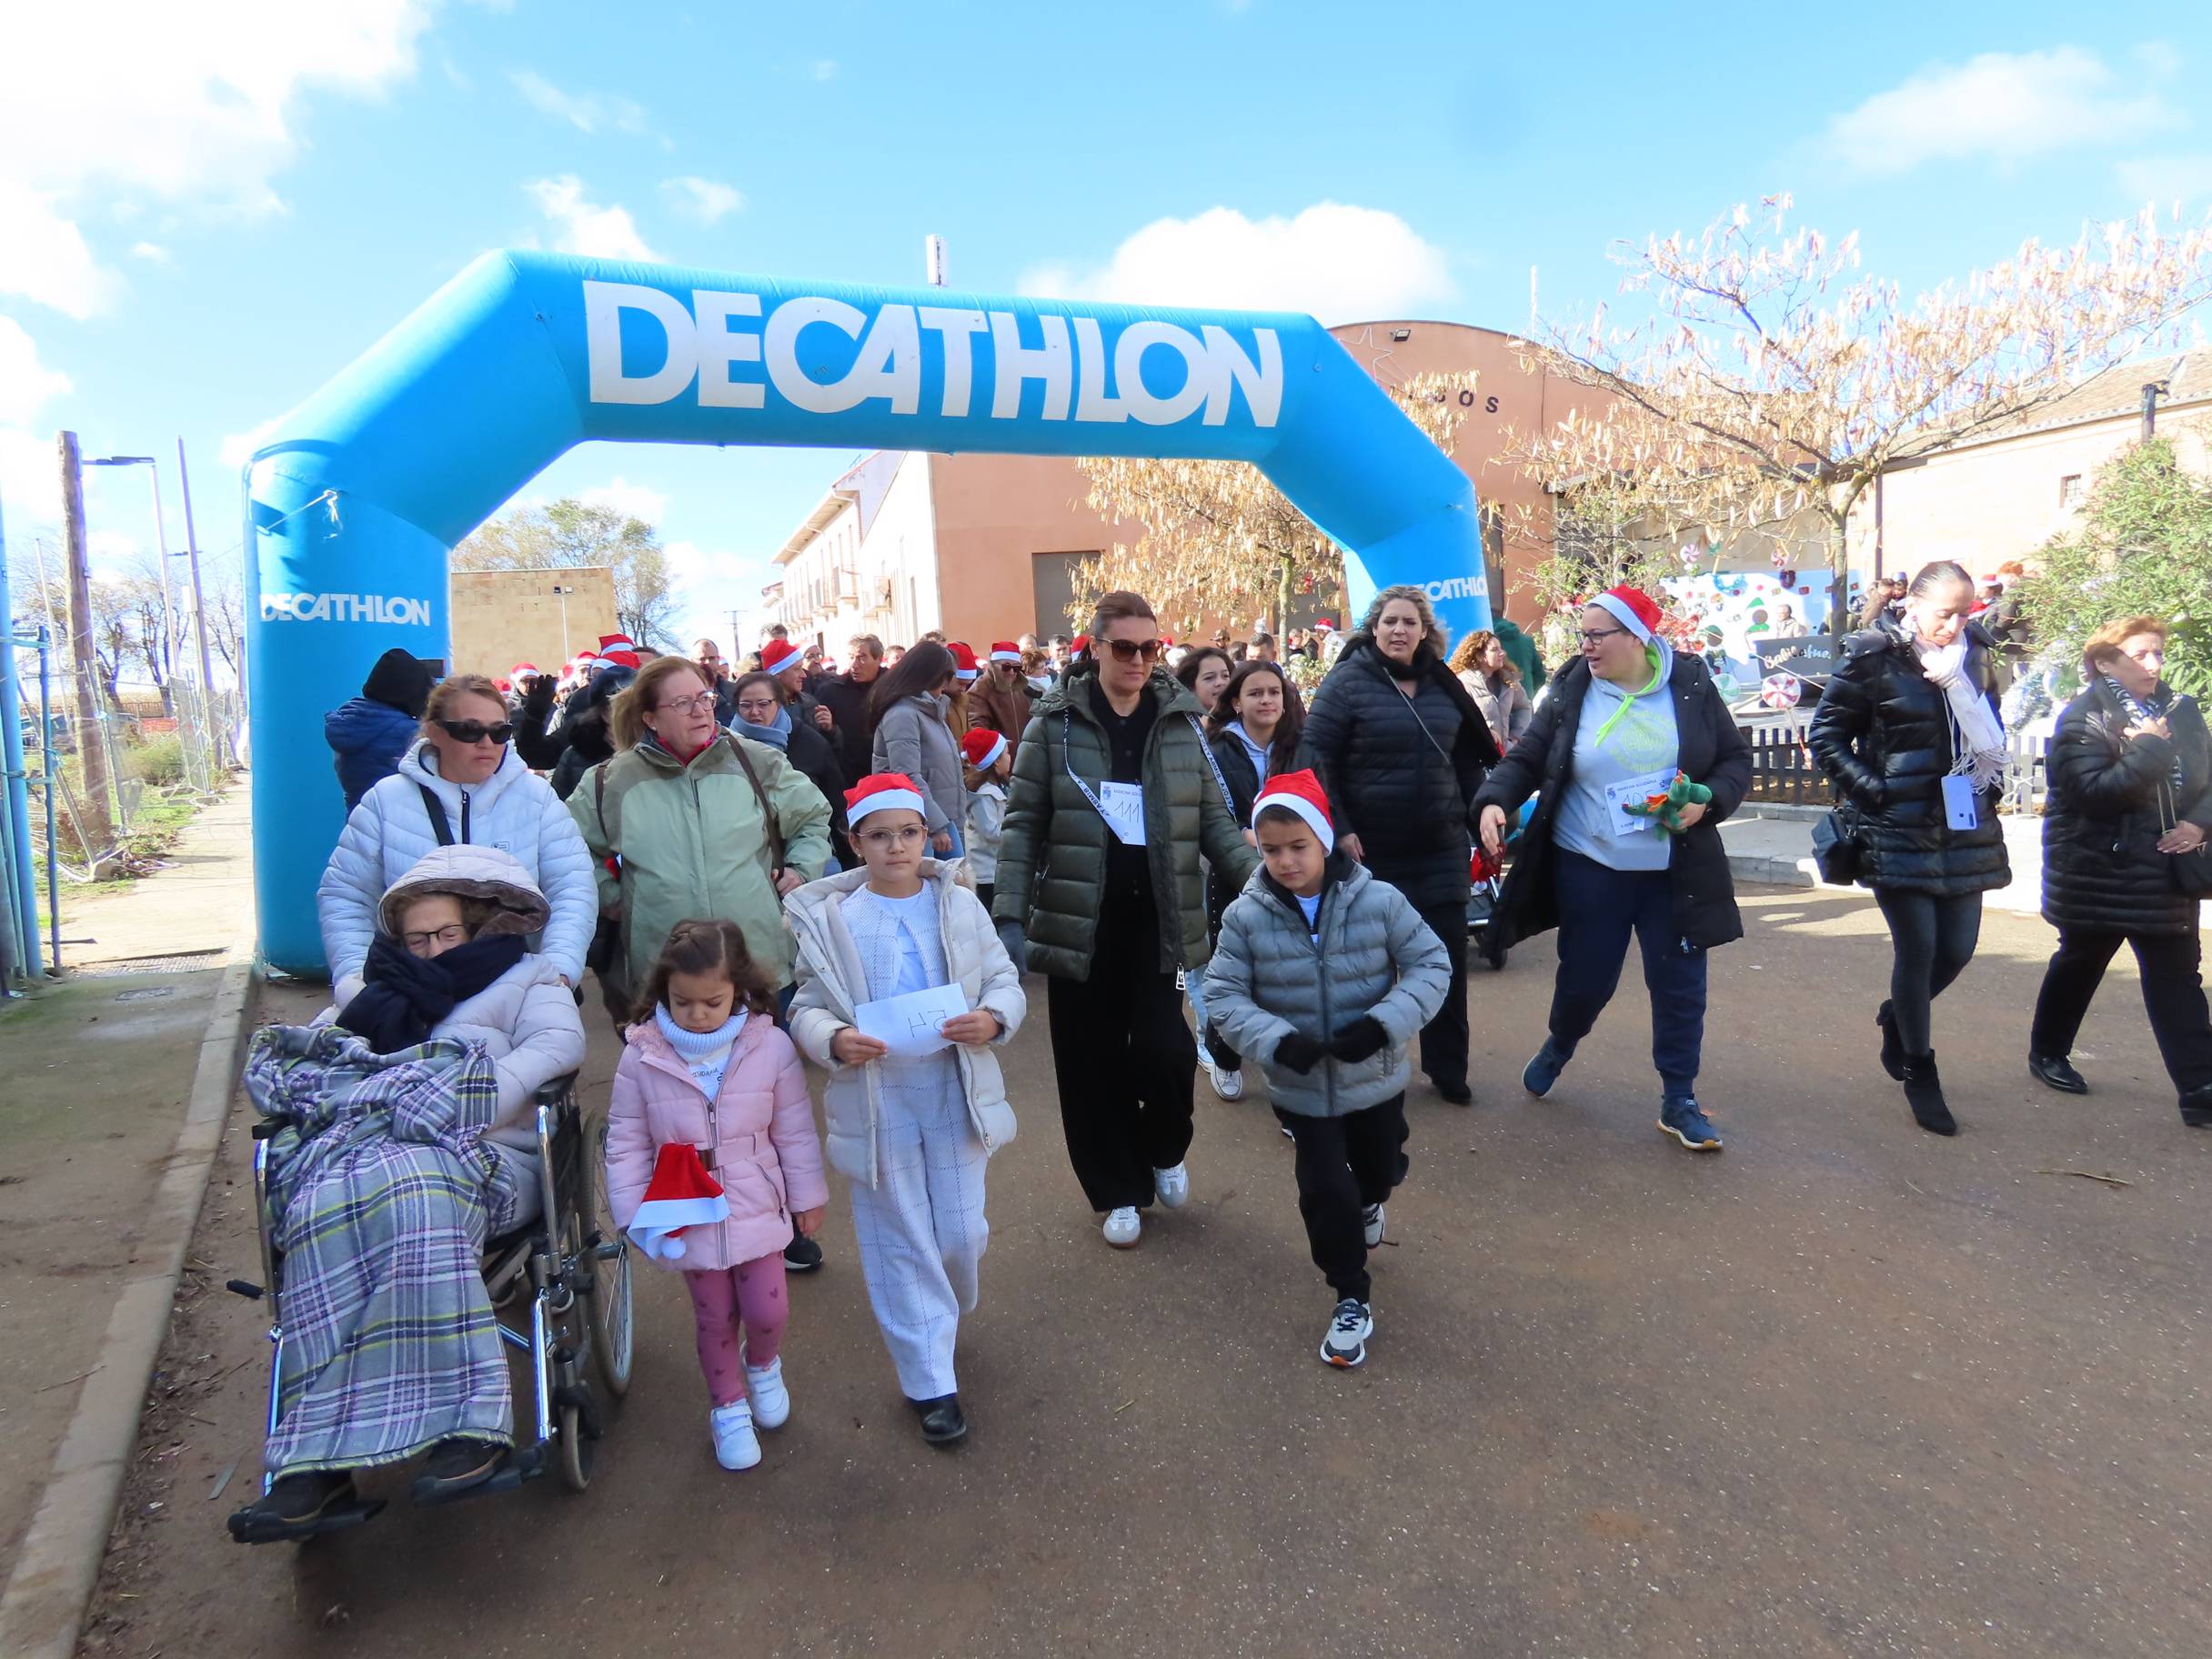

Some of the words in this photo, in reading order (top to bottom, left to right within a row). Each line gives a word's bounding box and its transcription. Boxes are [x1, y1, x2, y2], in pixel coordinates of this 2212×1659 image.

[583, 279, 1282, 427] DECATHLON
[1413, 574, 1489, 602] CATHLO
[260, 592, 431, 626] DECATHLON
[1114, 799, 1140, 823] 111
